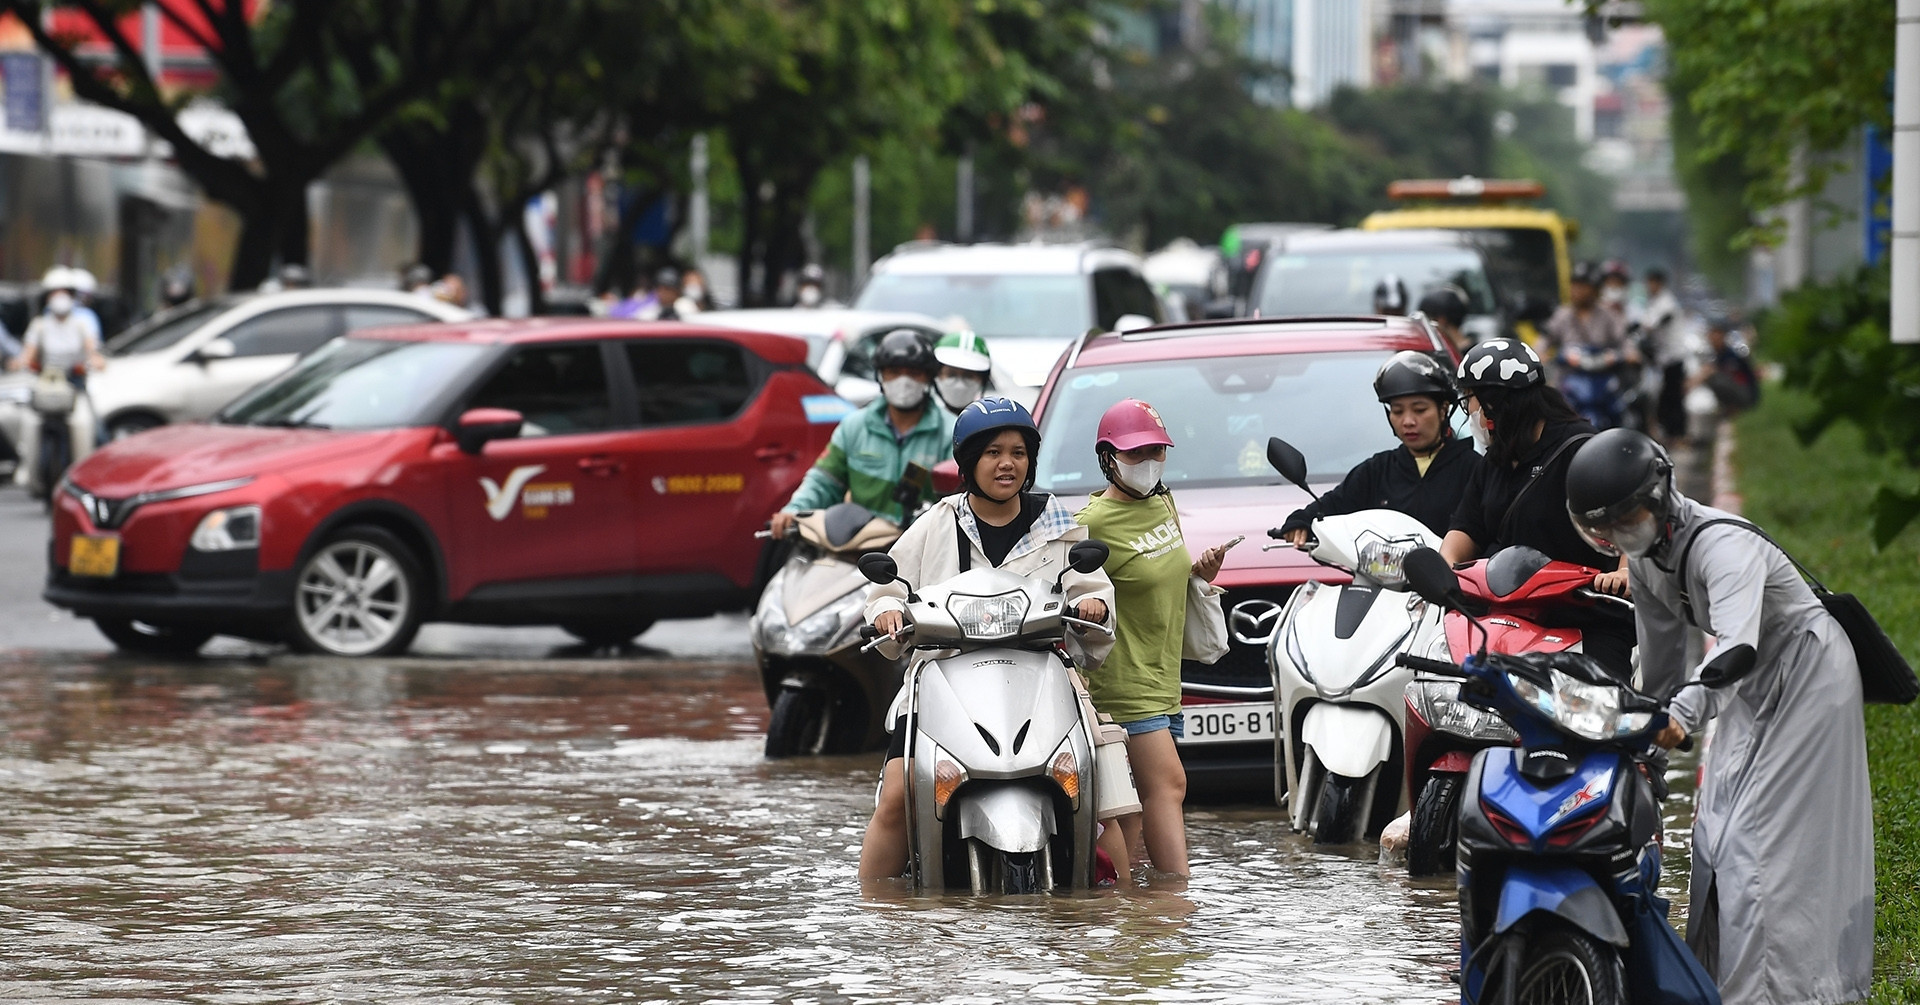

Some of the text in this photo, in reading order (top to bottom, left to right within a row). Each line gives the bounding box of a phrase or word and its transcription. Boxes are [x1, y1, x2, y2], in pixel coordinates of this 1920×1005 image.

[1490, 617, 1520, 628] HONDA
[1190, 711, 1283, 736] 30G-81
[1529, 750, 1569, 761] HONDA
